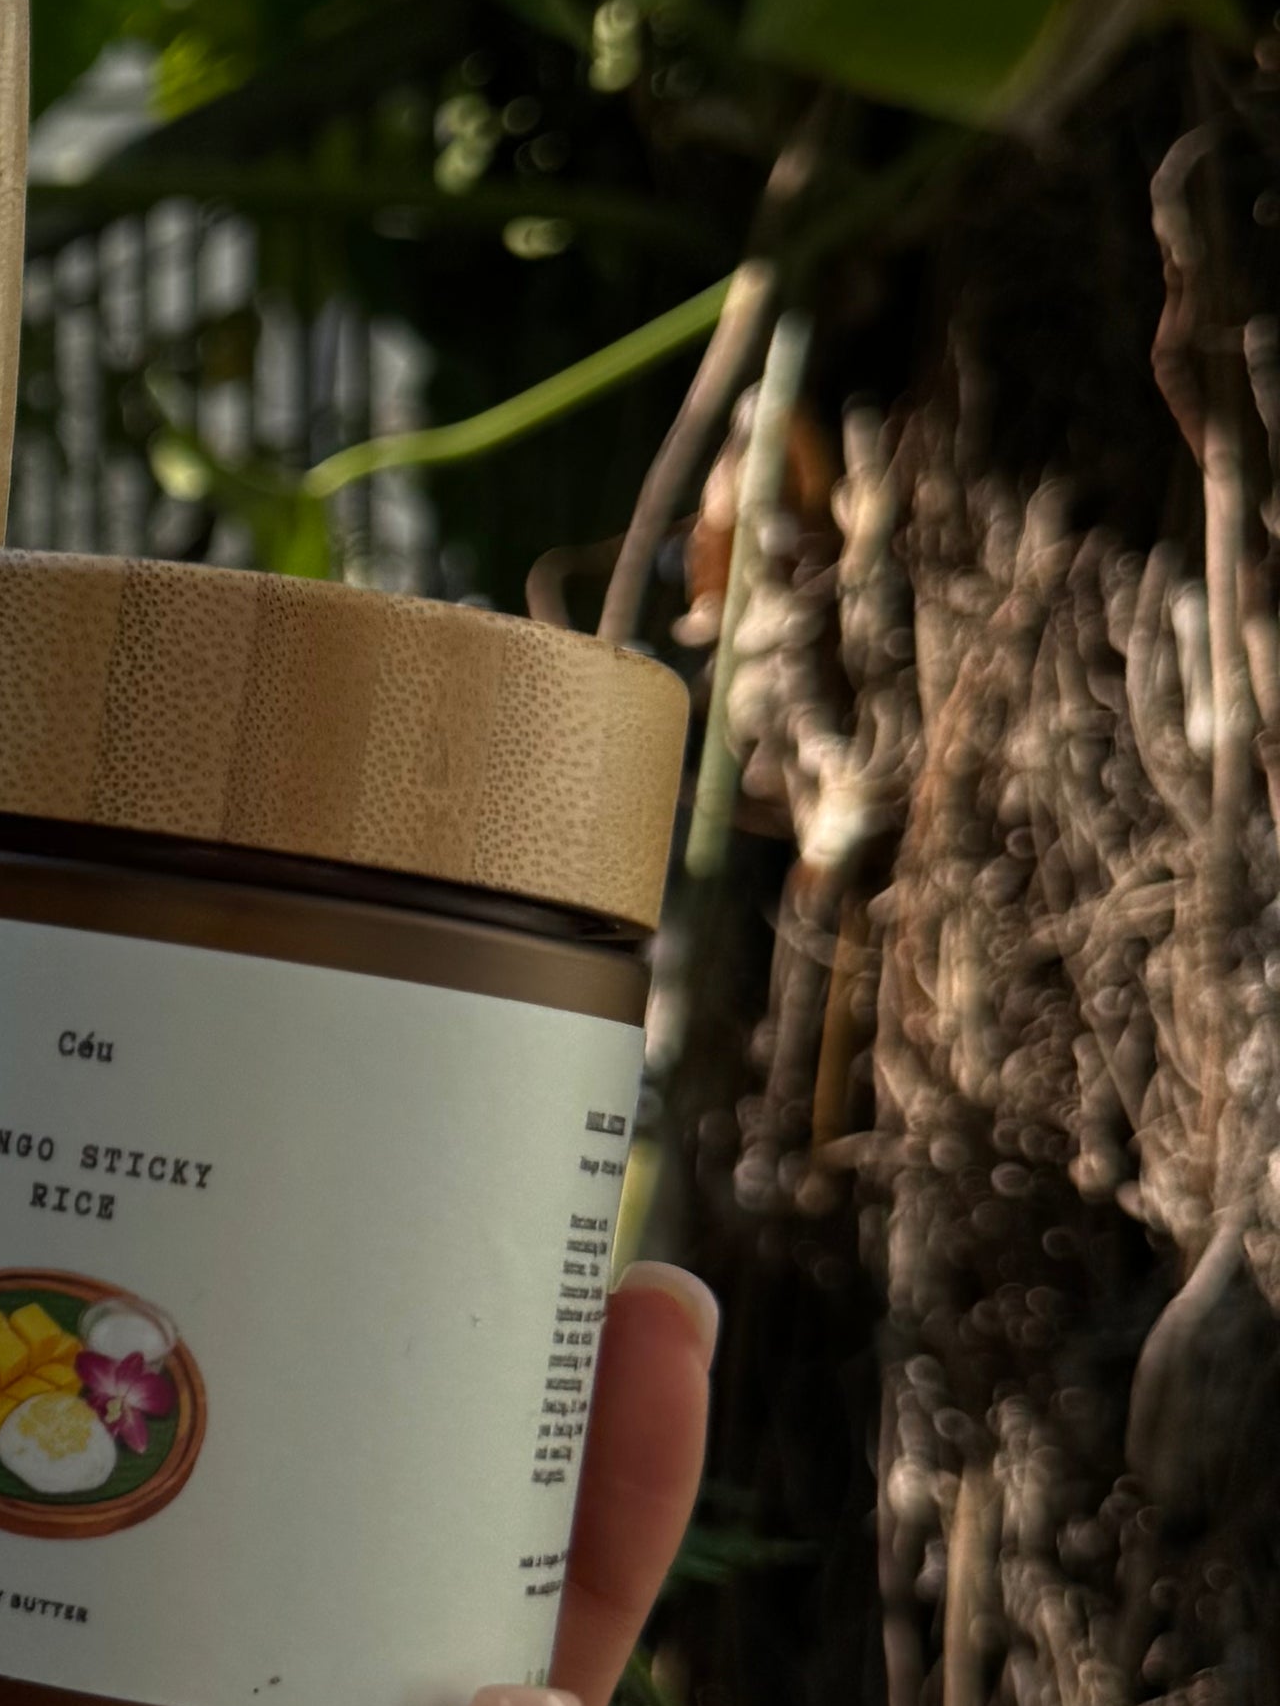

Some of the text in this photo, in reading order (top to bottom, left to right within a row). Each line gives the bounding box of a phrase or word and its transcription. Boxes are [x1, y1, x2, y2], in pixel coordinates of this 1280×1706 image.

[58, 1031, 113, 1063] Céu
[80, 1144, 212, 1189] STICKY
[30, 1182, 114, 1220] RICE
[10, 1594, 87, 1623] BUTTER
